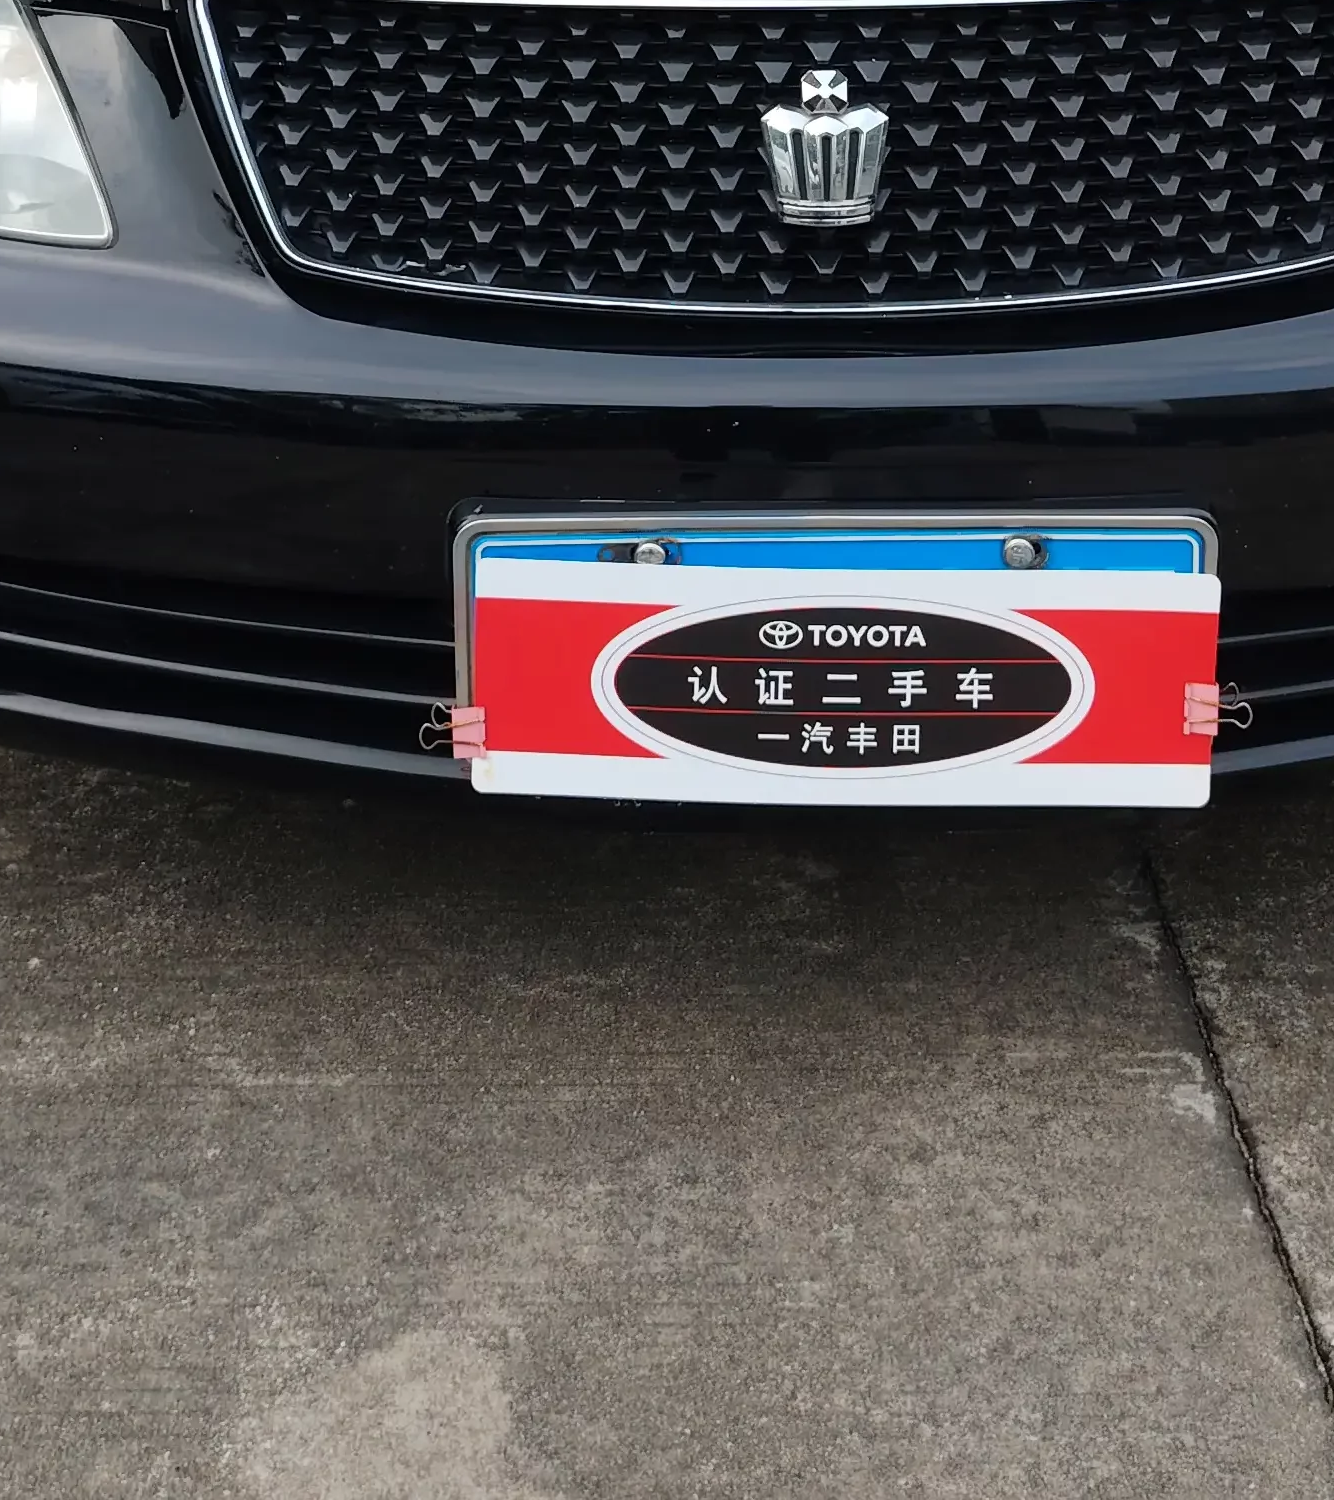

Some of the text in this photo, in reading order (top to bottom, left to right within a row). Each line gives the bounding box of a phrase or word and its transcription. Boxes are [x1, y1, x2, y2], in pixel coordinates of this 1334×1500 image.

[807, 624, 927, 648] TOYOTA
[687, 665, 994, 710] 认证二手车
[757, 721, 922, 755] 一汽丰田
